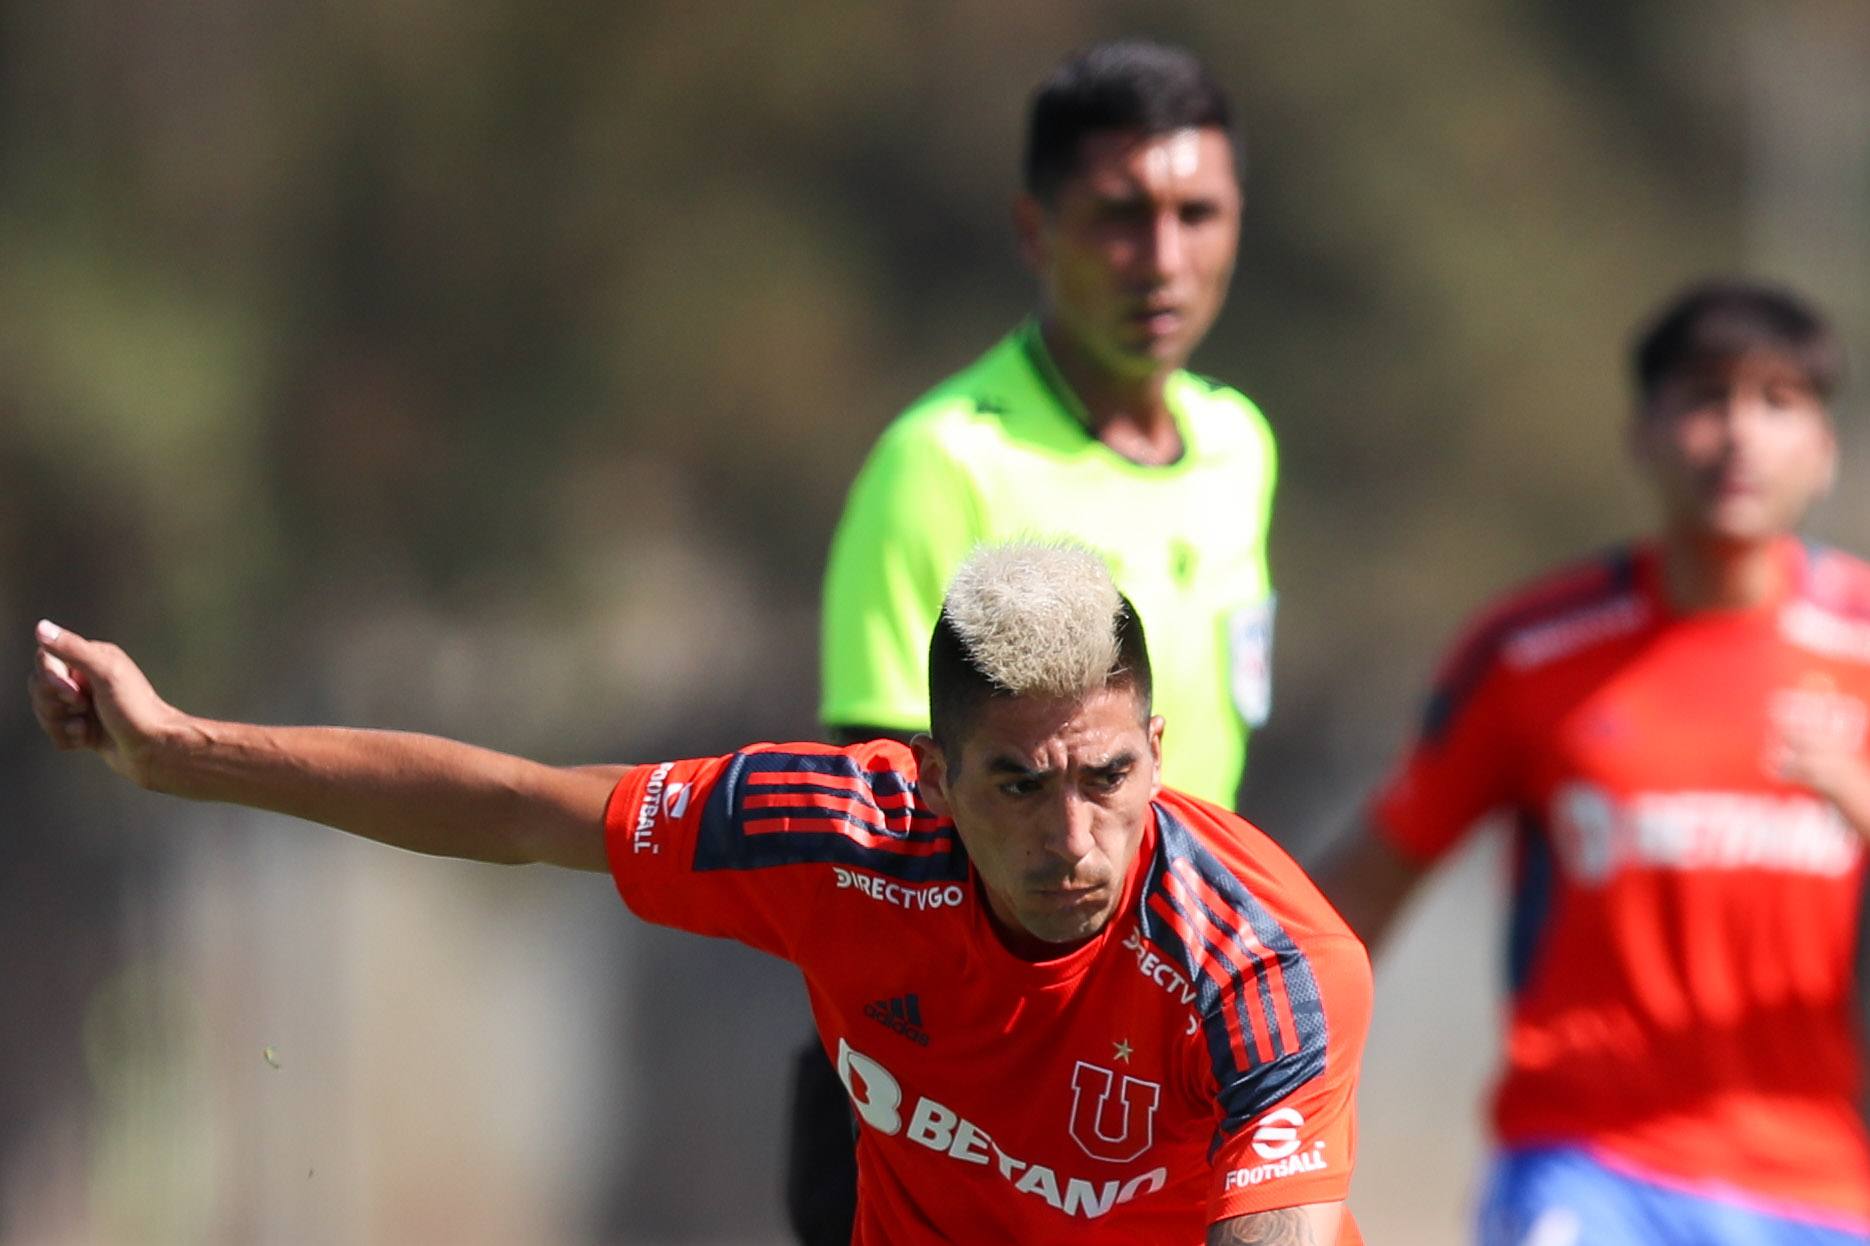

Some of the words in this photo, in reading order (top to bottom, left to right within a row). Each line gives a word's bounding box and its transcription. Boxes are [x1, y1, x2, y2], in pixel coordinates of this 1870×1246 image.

[633, 762, 675, 854] FOOTBALL
[864, 1004, 931, 1048] adidas
[905, 1096, 1168, 1219] BETANO
[1224, 1150, 1328, 1191] FOOTBALL
